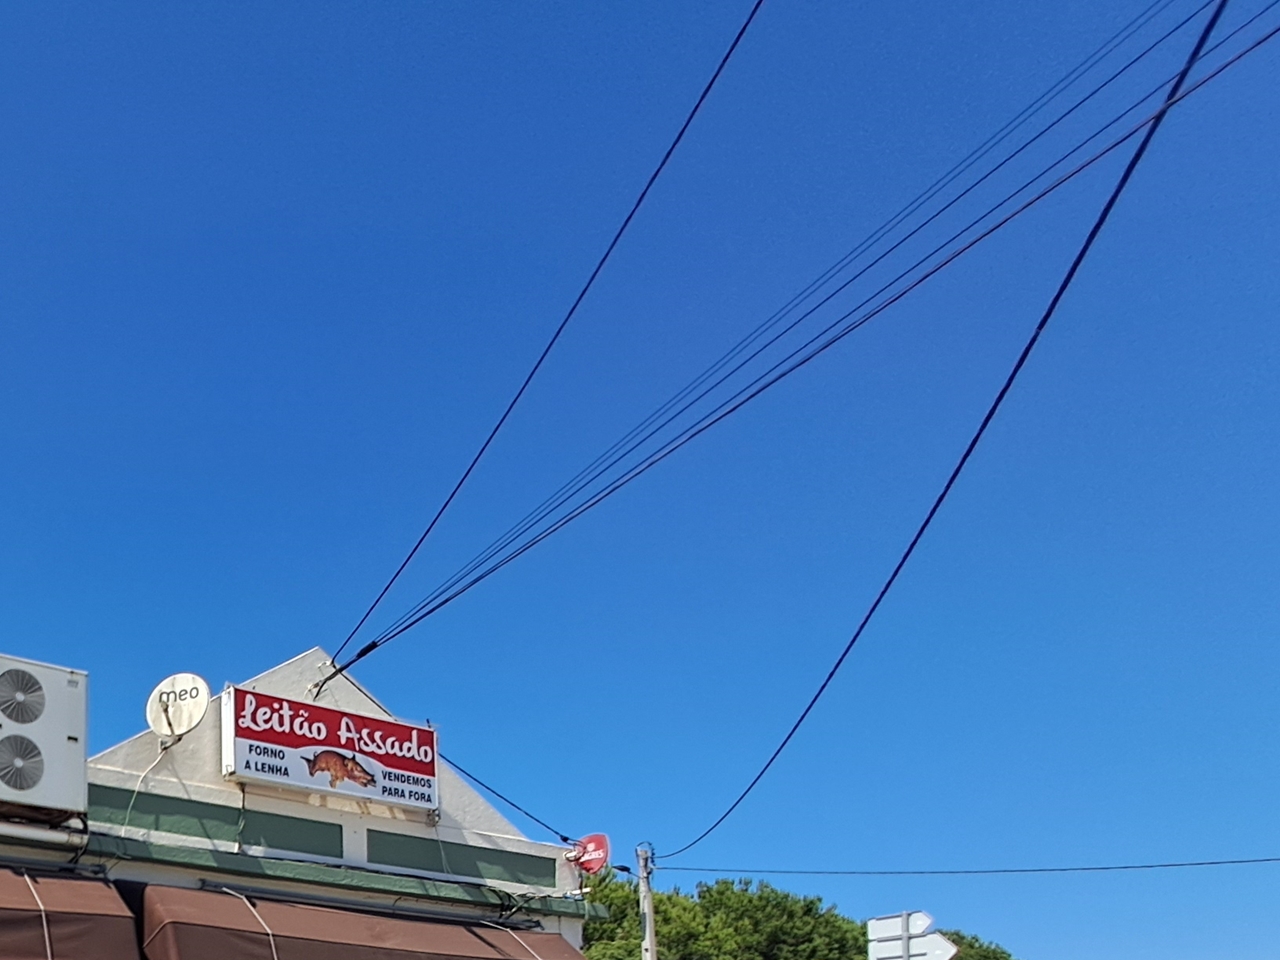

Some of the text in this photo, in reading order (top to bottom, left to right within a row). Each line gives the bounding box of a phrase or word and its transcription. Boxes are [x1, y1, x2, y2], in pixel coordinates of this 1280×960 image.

[159, 686, 199, 703] meo
[238, 694, 433, 763] Leitão Assado
[248, 744, 285, 760] FORNO
[254, 761, 290, 777] LENHA
[381, 770, 432, 789] VENDEMOS
[381, 786, 433, 803] PARA FORA
